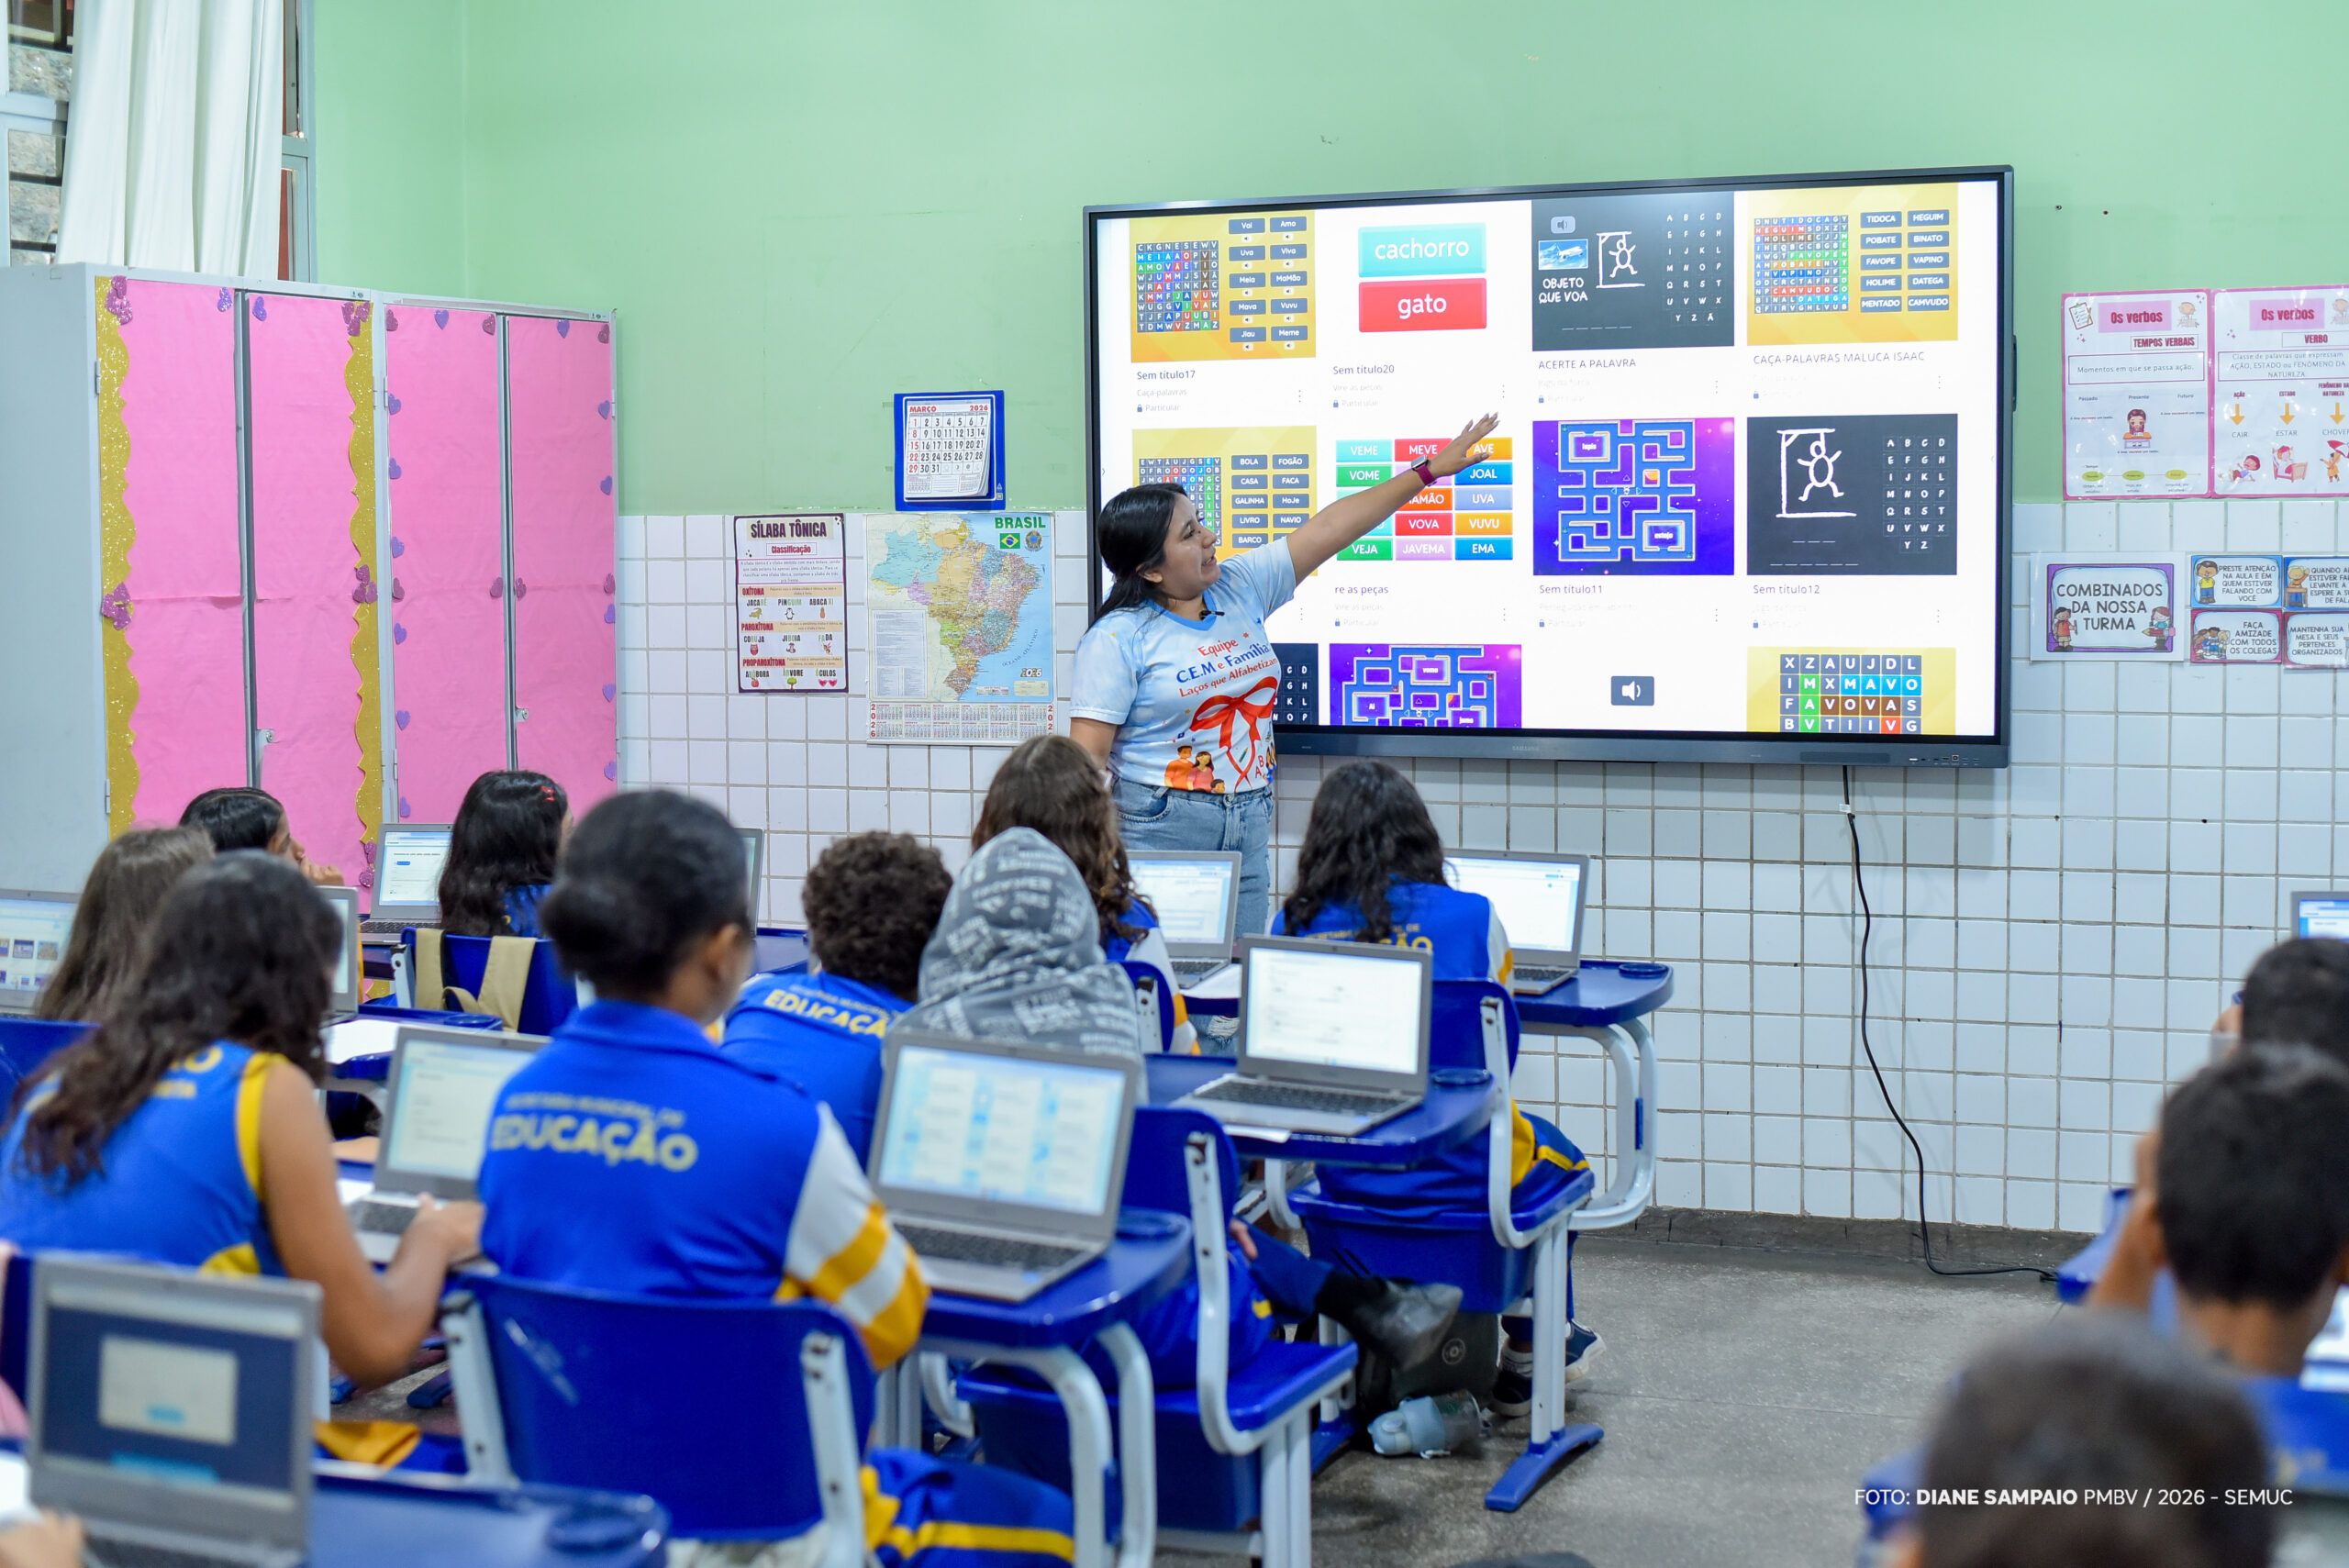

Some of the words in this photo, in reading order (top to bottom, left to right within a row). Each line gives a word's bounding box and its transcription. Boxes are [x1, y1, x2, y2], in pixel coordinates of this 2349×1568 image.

[1866, 215, 1896, 223] TIDOCA
[1913, 213, 1943, 222] HEGUIM
[1865, 236, 1897, 244] POBATE
[1913, 234, 1943, 243] BINATO
[1375, 237, 1470, 260] cachorro
[1865, 257, 1896, 265] FAVOPE
[1542, 277, 1585, 289] OBJETO
[1865, 278, 1896, 286] HOLIME
[1912, 276, 1943, 285] DATEGA
[1538, 292, 1562, 304] QUE
[1564, 291, 1588, 302] VOA
[1908, 298, 1948, 306] CAMVUDO
[1397, 294, 1447, 319] gato
[1862, 299, 1900, 308] MENTADO
[2110, 312, 2123, 324] Os
[2126, 311, 2163, 323] verbos
[2261, 309, 2275, 321] Os
[2277, 308, 2315, 320] verbos
[2133, 338, 2163, 348] TEMPOS
[2165, 337, 2195, 347] VERBAIS
[2304, 334, 2328, 344] VERBO
[1753, 353, 1841, 366] CAÇA-PALAVRAS
[1843, 352, 1890, 362] MALUCA
[1894, 351, 1924, 361] ISAAC
[1332, 366, 1354, 374] Sem
[1356, 364, 1395, 374] título20
[1539, 359, 1576, 369] ACERTE
[1579, 360, 1586, 368] A
[1589, 359, 1636, 368] PALAVRA
[1137, 372, 1157, 380] Sem
[1159, 370, 1196, 380] título17
[933, 429, 941, 438] 10
[944, 429, 952, 438] 11
[955, 428, 963, 437] 12
[966, 428, 974, 437] 13
[910, 441, 918, 450] 15
[922, 441, 930, 450] 16
[933, 441, 941, 450] 17
[944, 441, 952, 450] 18
[965, 440, 974, 449] 20
[976, 439, 984, 448] 21
[1408, 444, 1438, 455] MEVE
[1473, 443, 1494, 454] AVE
[1351, 445, 1378, 456] VEME
[1278, 457, 1302, 465] FOGÃO
[1349, 470, 1380, 481] VOME
[1470, 469, 1497, 479] JOAL
[1409, 492, 1444, 505] AMÃO
[1472, 494, 1495, 504] UVA
[995, 517, 1046, 528] BRASIL
[1408, 519, 1440, 529] VOVA
[1469, 518, 1500, 528] VUVU
[751, 520, 786, 538] SÍLABA
[789, 519, 827, 538] TÔNICA
[772, 545, 811, 555] Classificação
[1352, 544, 1378, 554] VEJA
[1402, 544, 1445, 554] JAVEMA
[1472, 543, 1496, 554] EMA
[742, 586, 764, 595] OXÍTONA
[1334, 586, 1345, 595] re
[1347, 586, 1358, 595] as
[1361, 586, 1389, 596] peças
[1539, 584, 1561, 594] Sem
[1564, 584, 1603, 594] título11
[1753, 584, 1776, 594] Sem
[1778, 584, 1820, 595] título12
[2056, 584, 2163, 597] COMBINADOS
[2072, 601, 2090, 613] DA
[2097, 600, 2147, 613] NOSSA
[741, 622, 774, 631] PAROXÍTONA
[2083, 617, 2135, 630] TURMA
[1197, 639, 1239, 657] Equipe
[743, 657, 785, 666] PROPAROXÍTONA
[1176, 662, 1217, 683] C.E.M
[1224, 643, 1271, 667] Família
[1020, 668, 1042, 677] 2026
[1179, 682, 1208, 697] Laços
[1210, 677, 1227, 688] que
